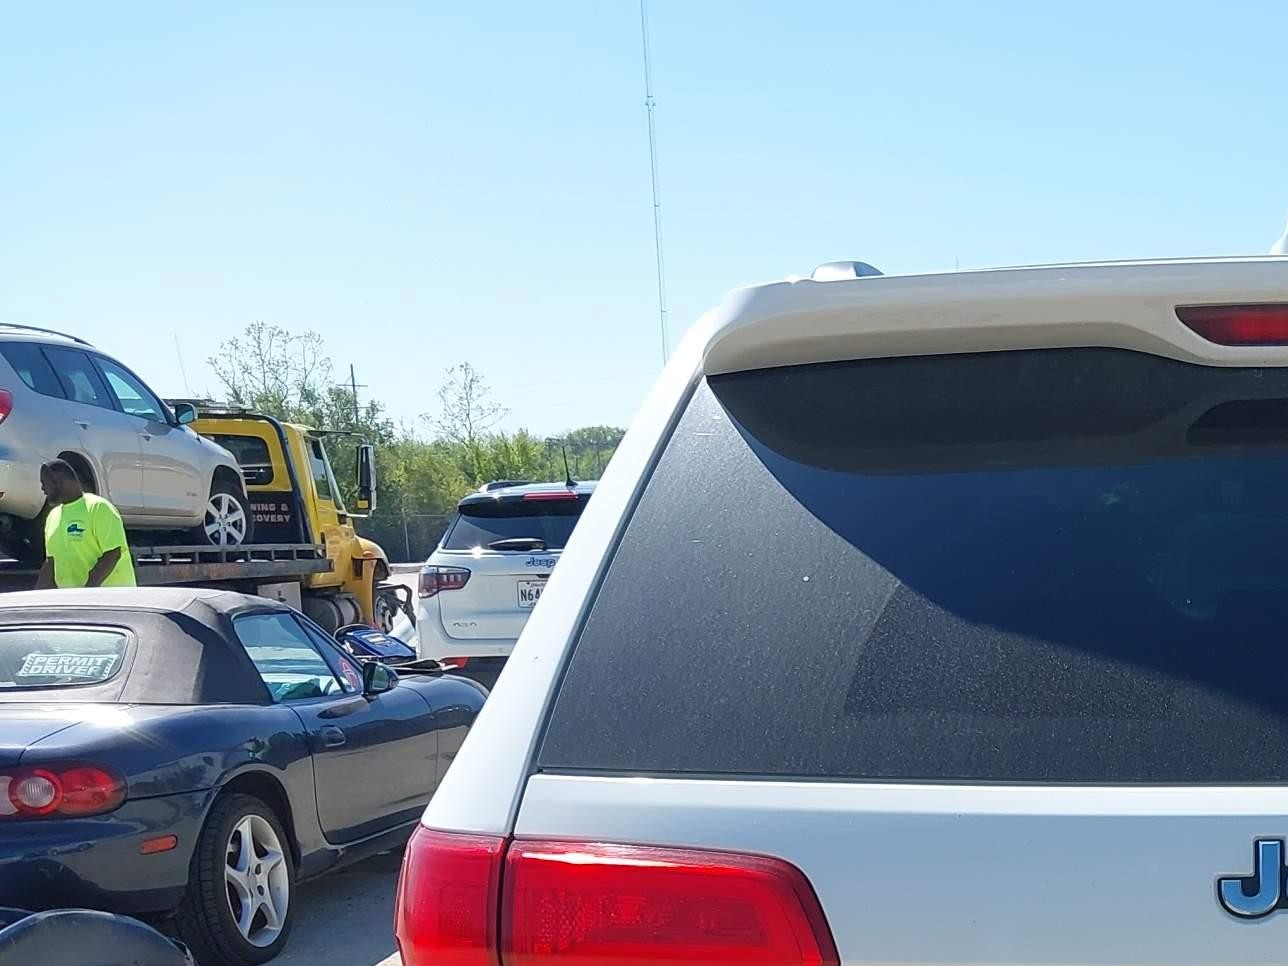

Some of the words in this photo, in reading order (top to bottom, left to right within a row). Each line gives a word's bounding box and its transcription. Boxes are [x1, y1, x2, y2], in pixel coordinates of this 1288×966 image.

[525, 557, 556, 568] Jeep
[33, 656, 107, 667] PERMIT
[28, 665, 101, 676] DRIVER
